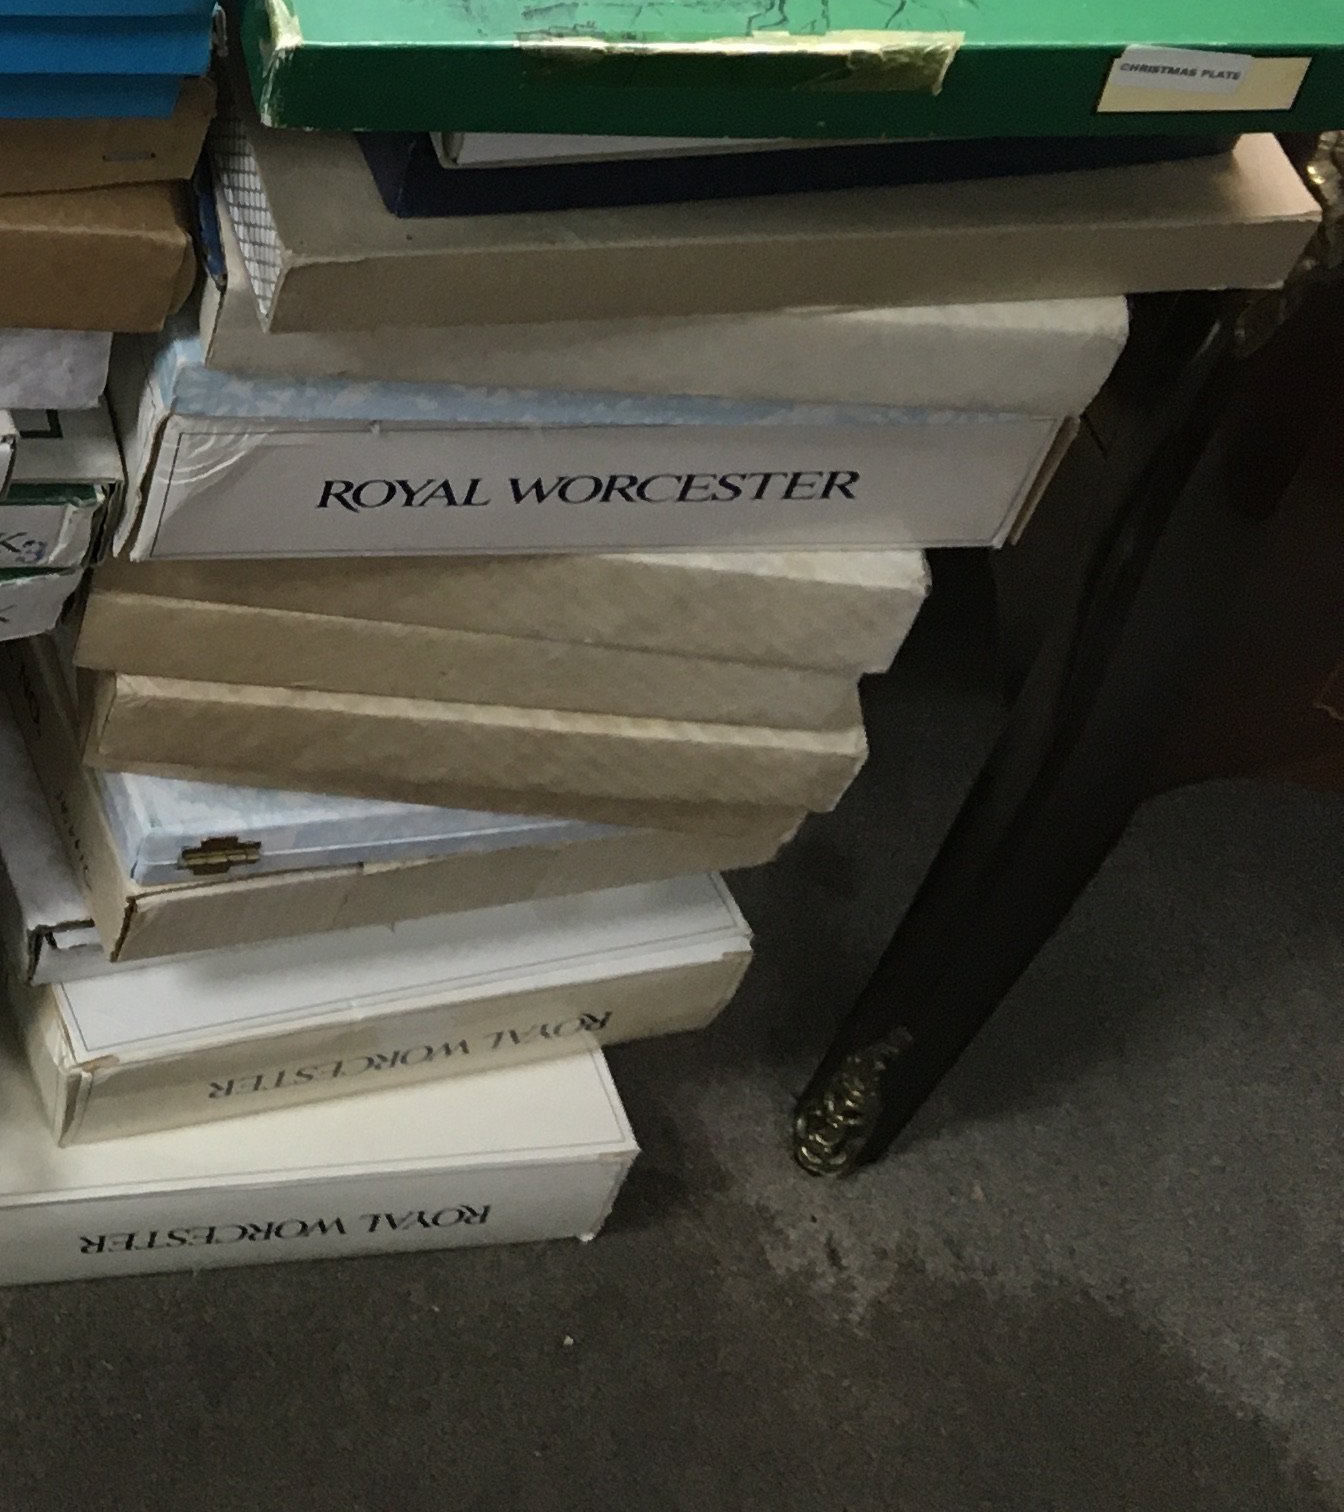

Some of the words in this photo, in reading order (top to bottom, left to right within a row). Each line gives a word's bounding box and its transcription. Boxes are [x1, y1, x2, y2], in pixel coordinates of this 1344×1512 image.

[1120, 62, 1198, 78] CHRISTMAS
[1201, 69, 1243, 81] PLATE
[317, 478, 492, 513] ROYAL
[509, 469, 861, 506] WORCESTER
[486, 1011, 613, 1050] ROYAL
[208, 1039, 470, 1099] WORCESTER
[79, 1216, 348, 1255] WORCESTER
[362, 1204, 493, 1233] ROYAL
